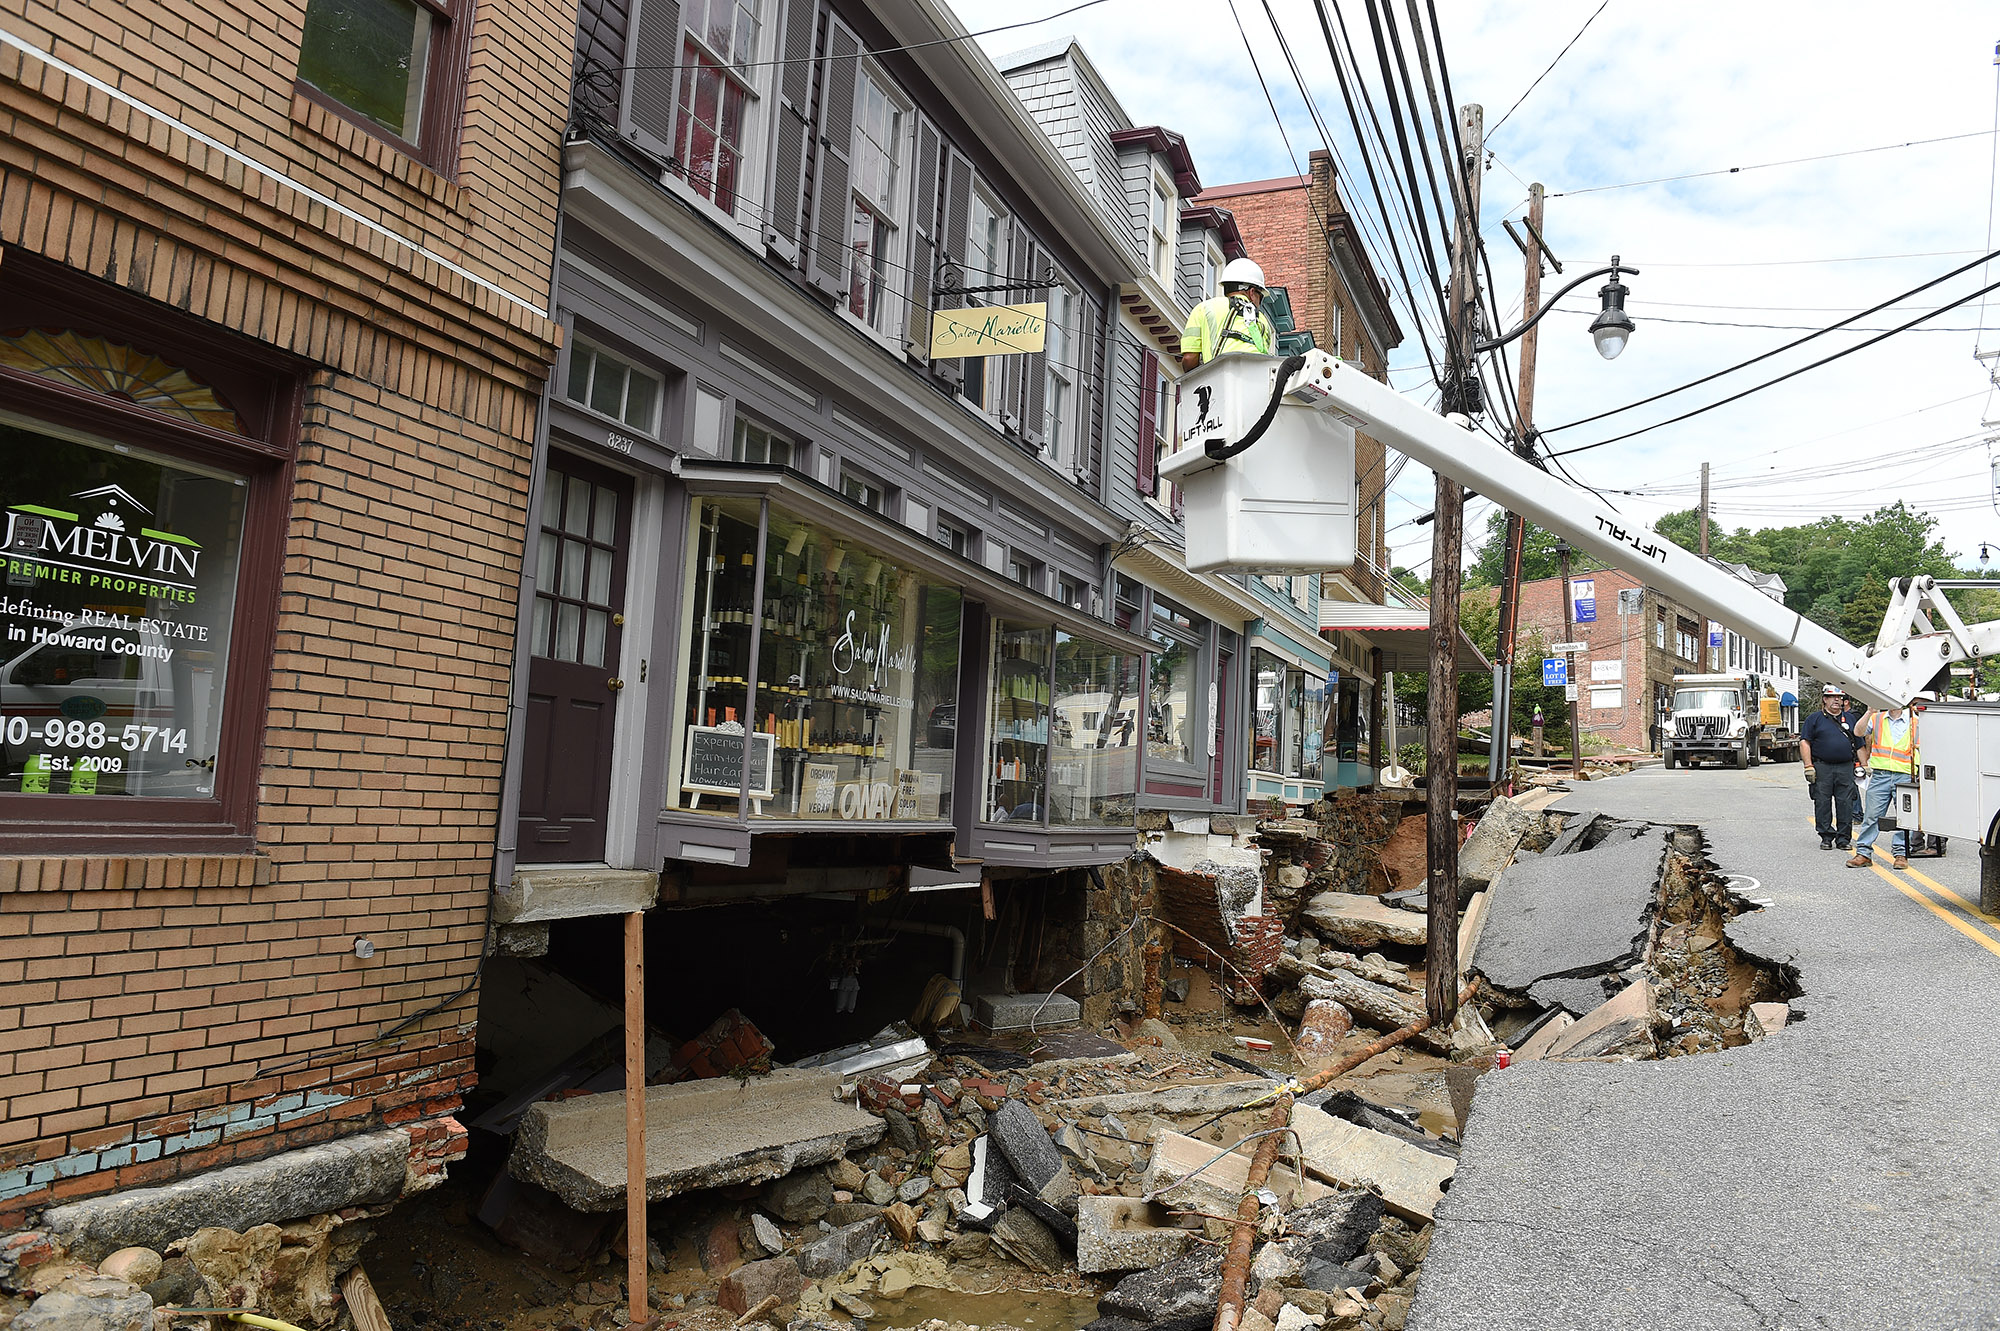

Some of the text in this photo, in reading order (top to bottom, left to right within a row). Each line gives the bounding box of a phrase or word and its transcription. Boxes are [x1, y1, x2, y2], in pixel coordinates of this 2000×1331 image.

[935, 315, 1041, 346] Salon Marielle
[607, 432, 634, 454] 8237
[38, 518, 202, 579] MELVIN
[1595, 515, 1667, 563] LIFT-ALL
[89, 574, 196, 604] PROPERTIES
[80, 608, 135, 631] REAL
[138, 617, 209, 642] ESTATE
[7, 623, 174, 662] in Howard County
[832, 610, 917, 687] Salon Marielle
[1553, 660, 1565, 673] P
[830, 684, 915, 710] WWW.SALONMARIELLE.COM
[38, 753, 122, 773] Est. 2009
[694, 763, 744, 778] Hair Car
[737, 756, 766, 768] Cair
[810, 768, 835, 780] ORGANIC
[840, 783, 899, 820] OWAY
[902, 786, 916, 795] FREE
[808, 802, 831, 814] VEGAN
